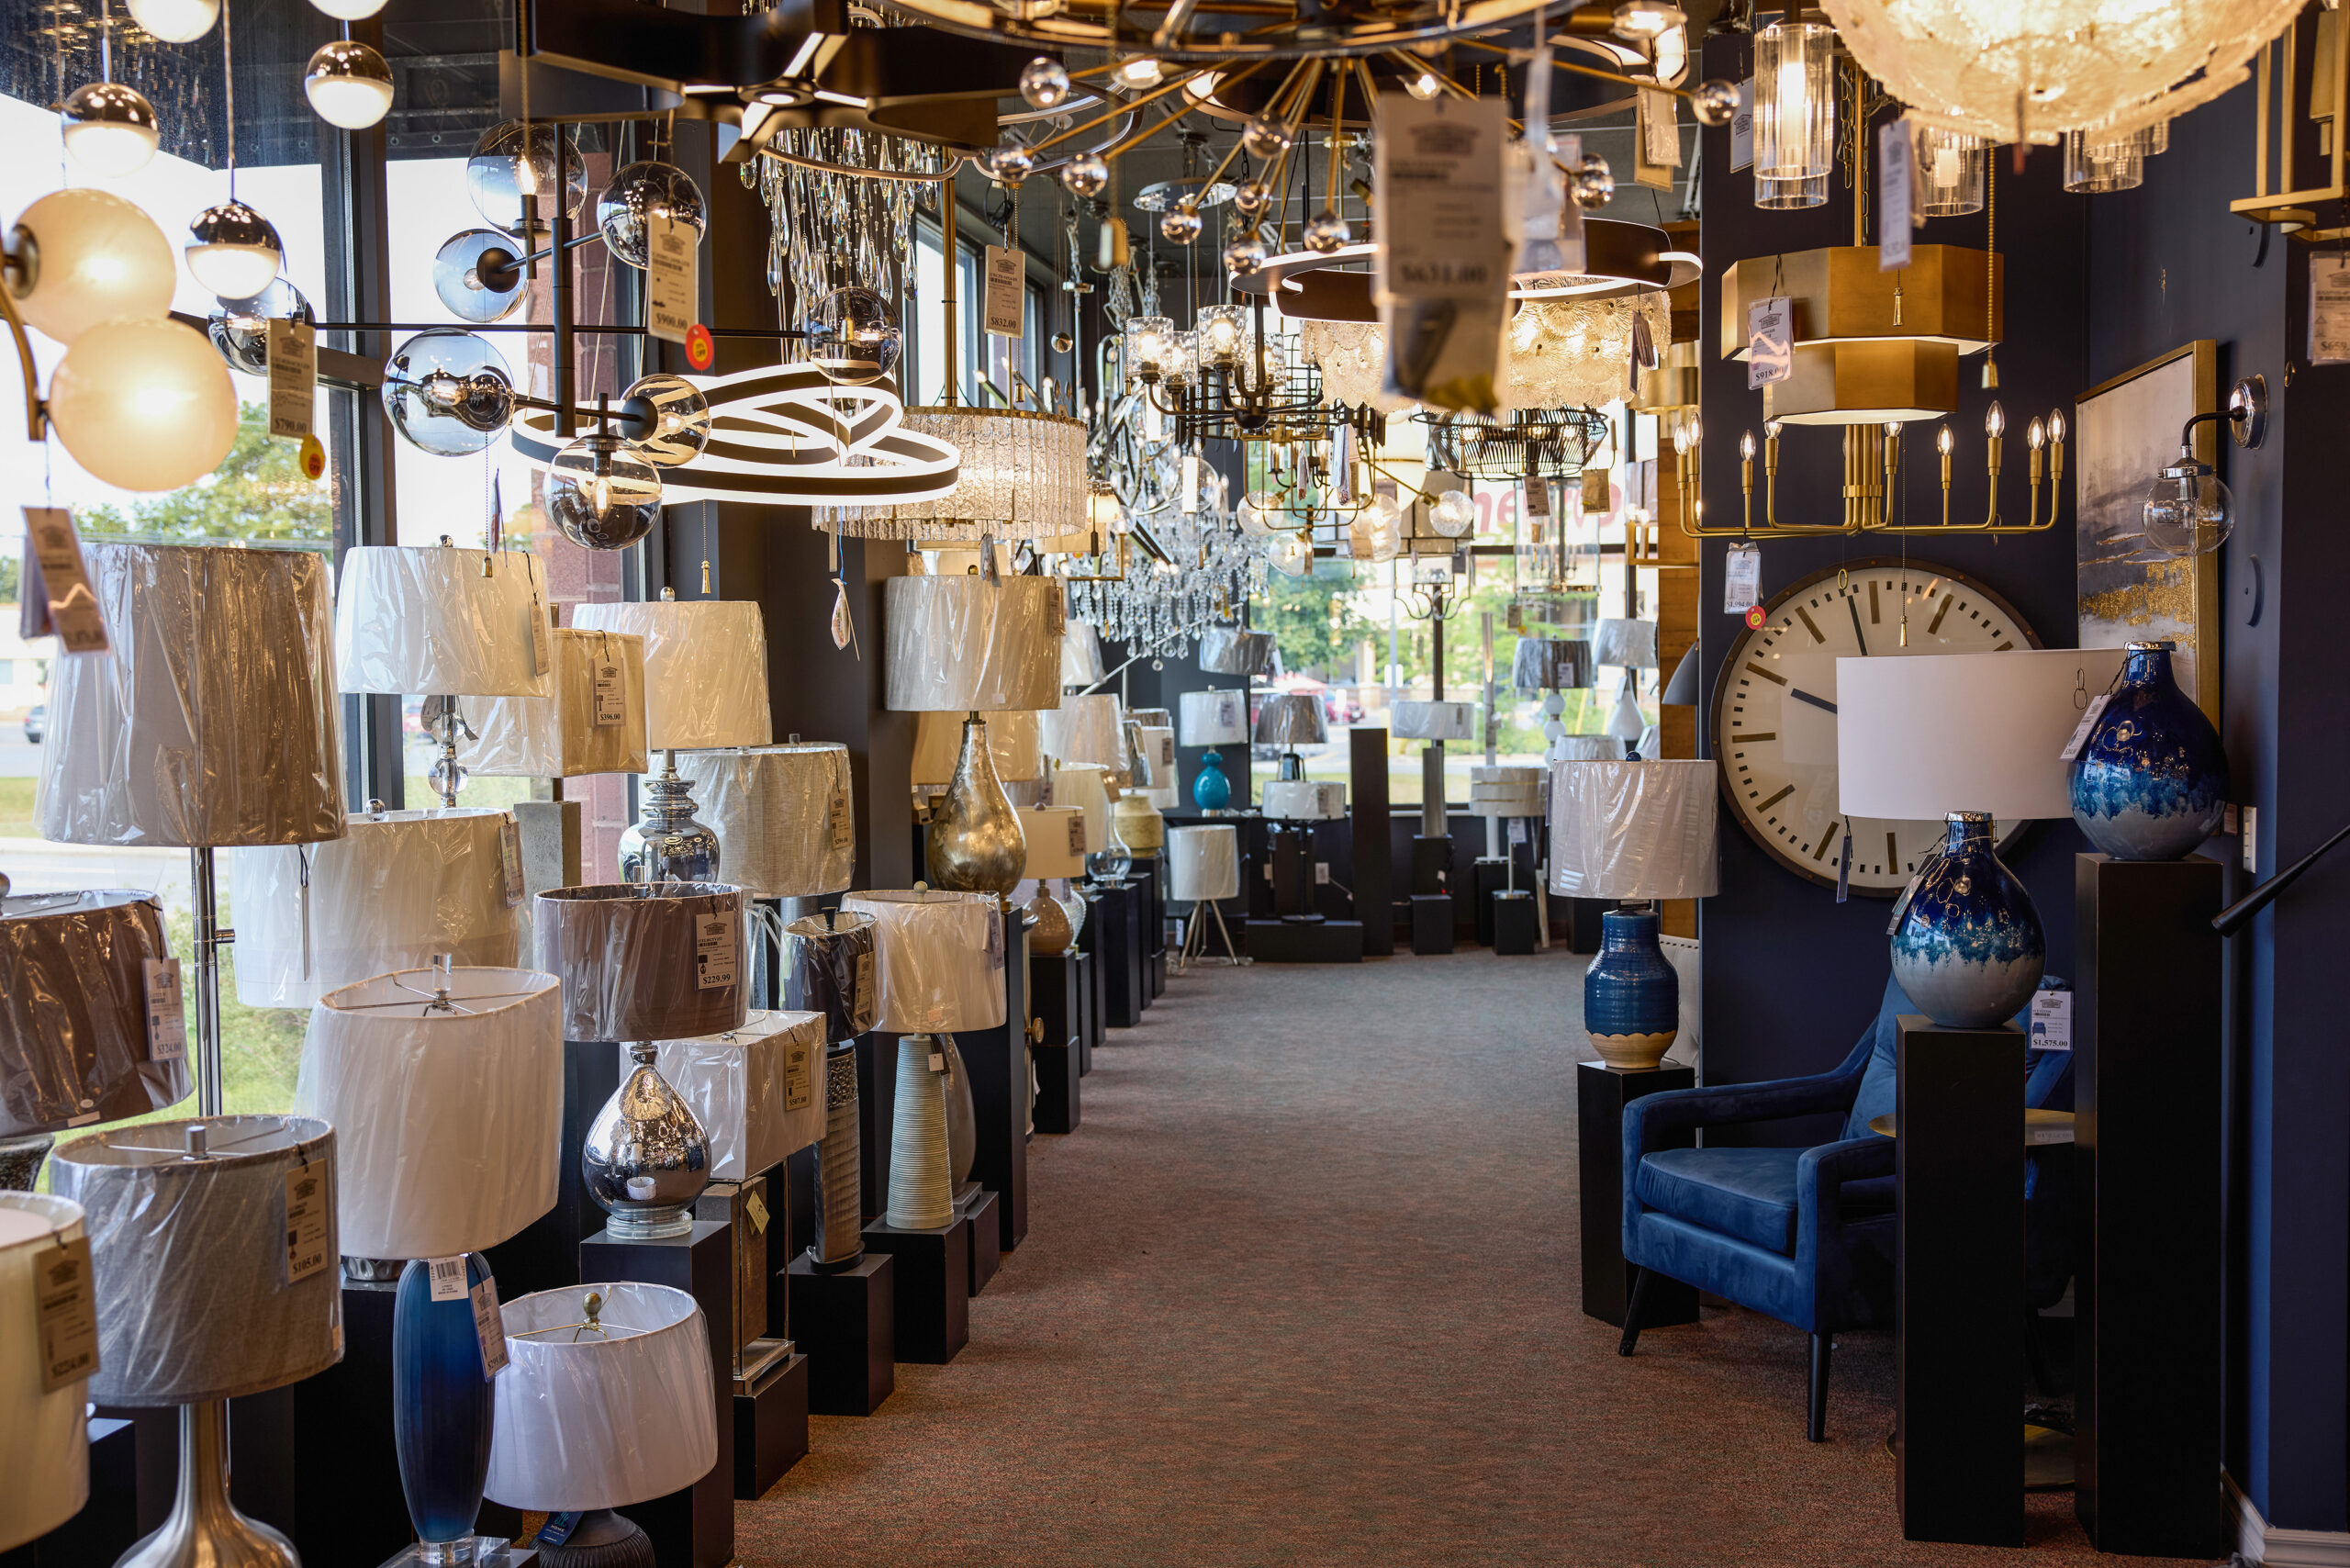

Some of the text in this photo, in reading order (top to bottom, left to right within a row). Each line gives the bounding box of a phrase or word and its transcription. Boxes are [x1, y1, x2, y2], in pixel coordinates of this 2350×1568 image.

[991, 317, 1016, 329] $832.00
[274, 418, 308, 434] $790.00
[600, 713, 621, 722] $396.00
[703, 974, 731, 984] $229.99
